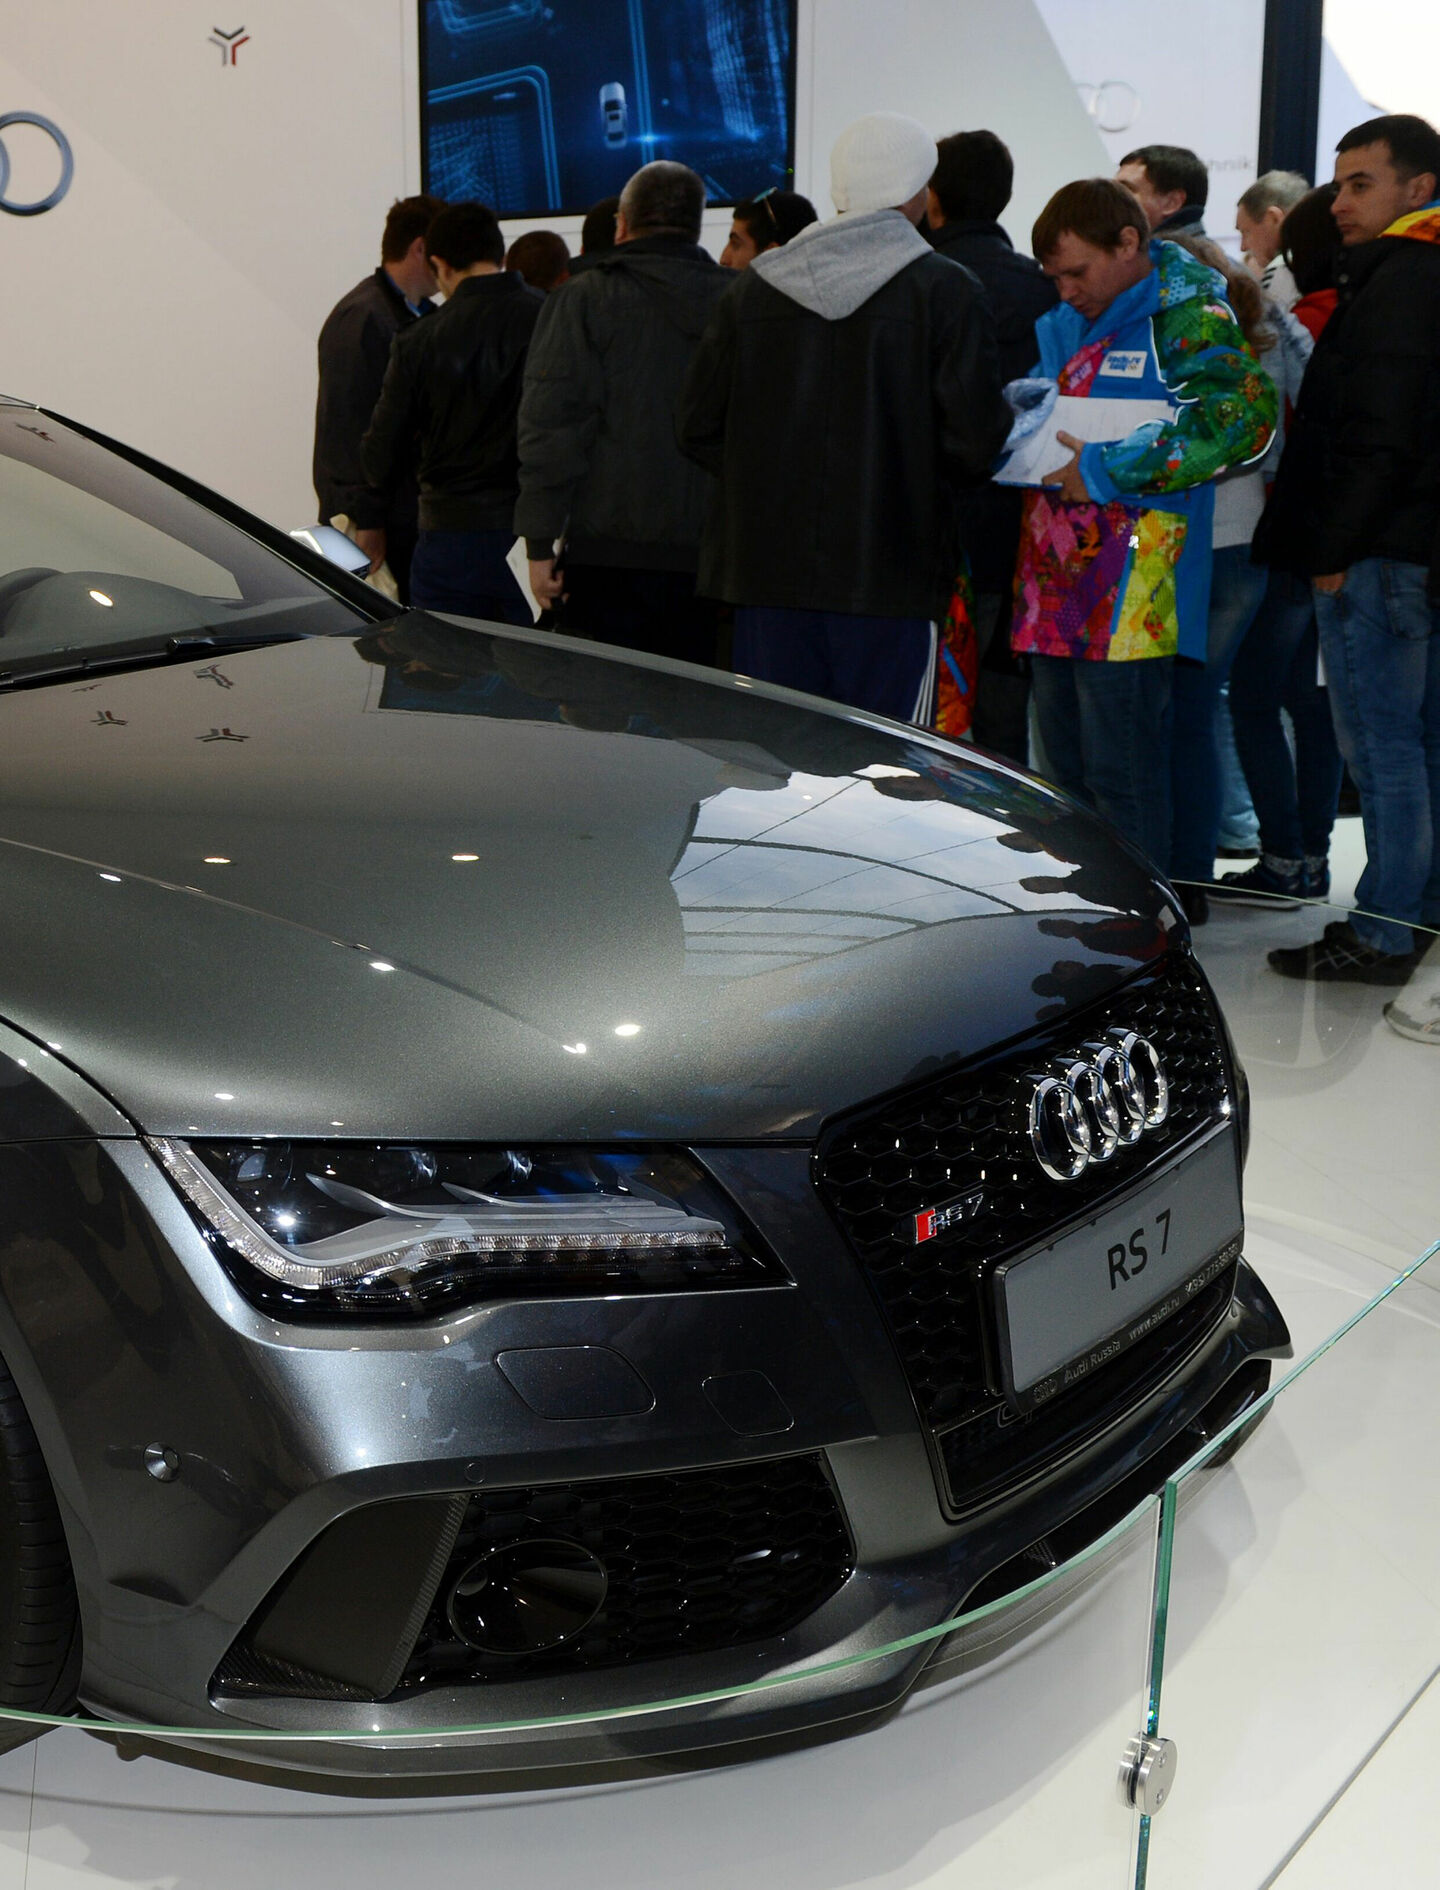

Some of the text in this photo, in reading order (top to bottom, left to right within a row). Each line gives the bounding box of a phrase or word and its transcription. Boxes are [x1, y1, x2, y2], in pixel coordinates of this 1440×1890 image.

[1107, 1228, 1148, 1291] RS
[1155, 1208, 1172, 1256] 7
[1064, 1361, 1089, 1384] Audi
[1090, 1341, 1121, 1367] Russia
